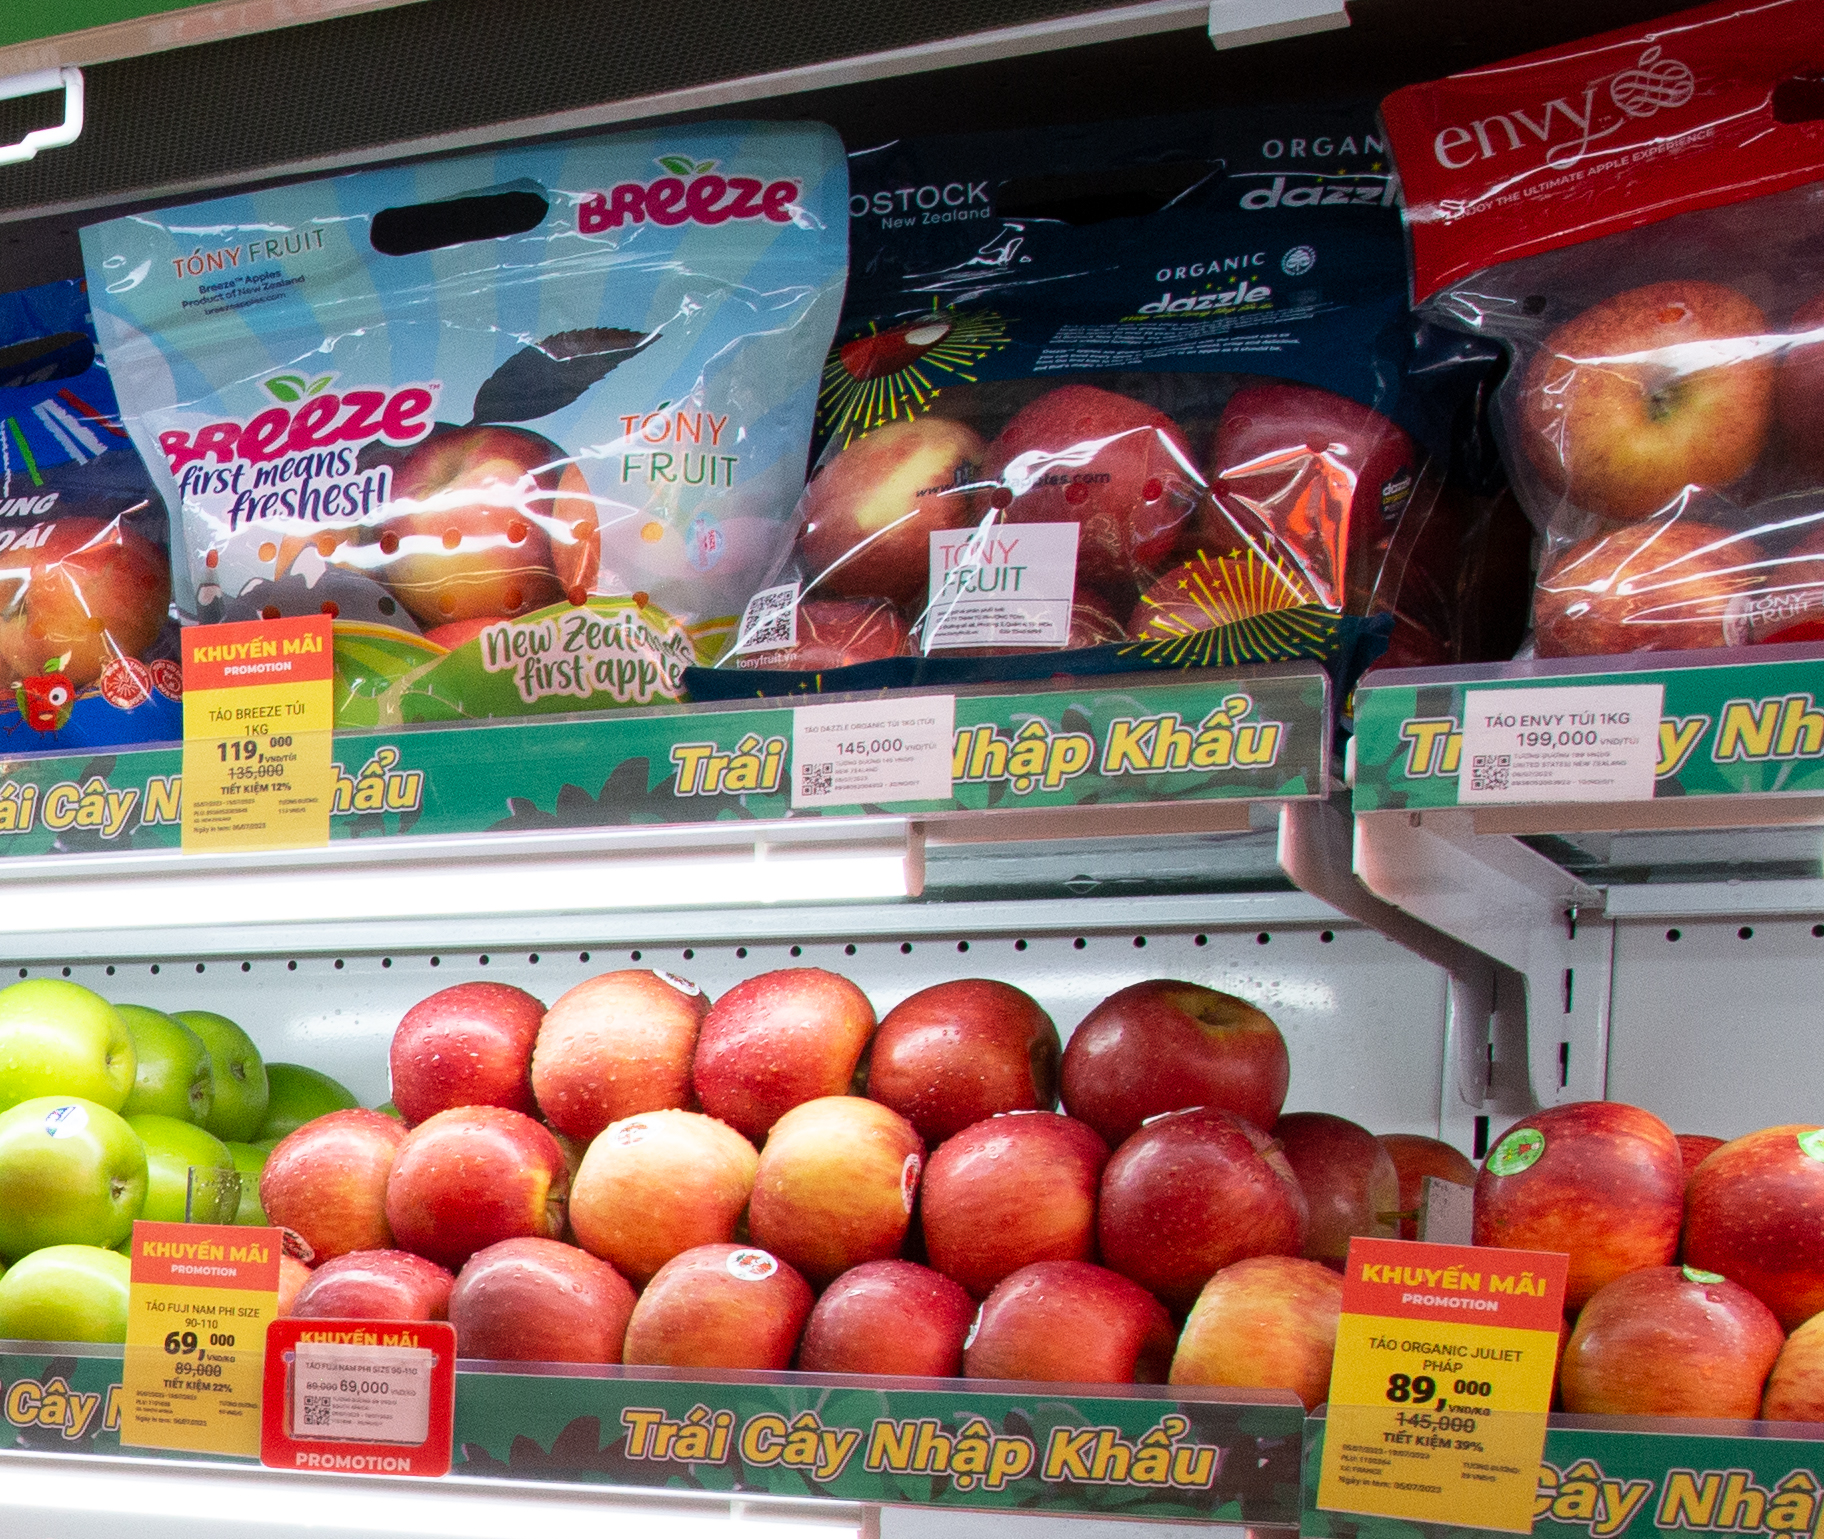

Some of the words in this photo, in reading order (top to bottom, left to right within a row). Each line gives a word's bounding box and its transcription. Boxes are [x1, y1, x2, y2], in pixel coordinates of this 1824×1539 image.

[1434, 88, 1626, 170] envy
[881, 212, 917, 231] New
[922, 204, 991, 227] Zealand
[173, 246, 241, 279] TÓNY
[249, 228, 325, 263] FRUIT
[1155, 250, 1267, 283] ORGANIC
[619, 401, 730, 446] TÓNY
[179, 465, 245, 499] first
[253, 447, 353, 490] means
[621, 450, 738, 489] FRUIT
[209, 707, 232, 722] TÁO
[235, 704, 282, 720] BREEZE
[286, 700, 305, 716] TÚI
[836, 738, 902, 756] 145,000
[220, 782, 240, 795] TIẾT
[243, 782, 269, 795] KIỆM
[271, 781, 292, 792] 12%
[228, 764, 284, 780] 135,000
[1361, 1262, 1481, 1292] KHUYẾN
[1489, 1271, 1547, 1297] MÃI
[1369, 1336, 1398, 1351] TÁO
[1401, 1340, 1468, 1357] ORGANIC
[1471, 1346, 1524, 1363] JULIET
